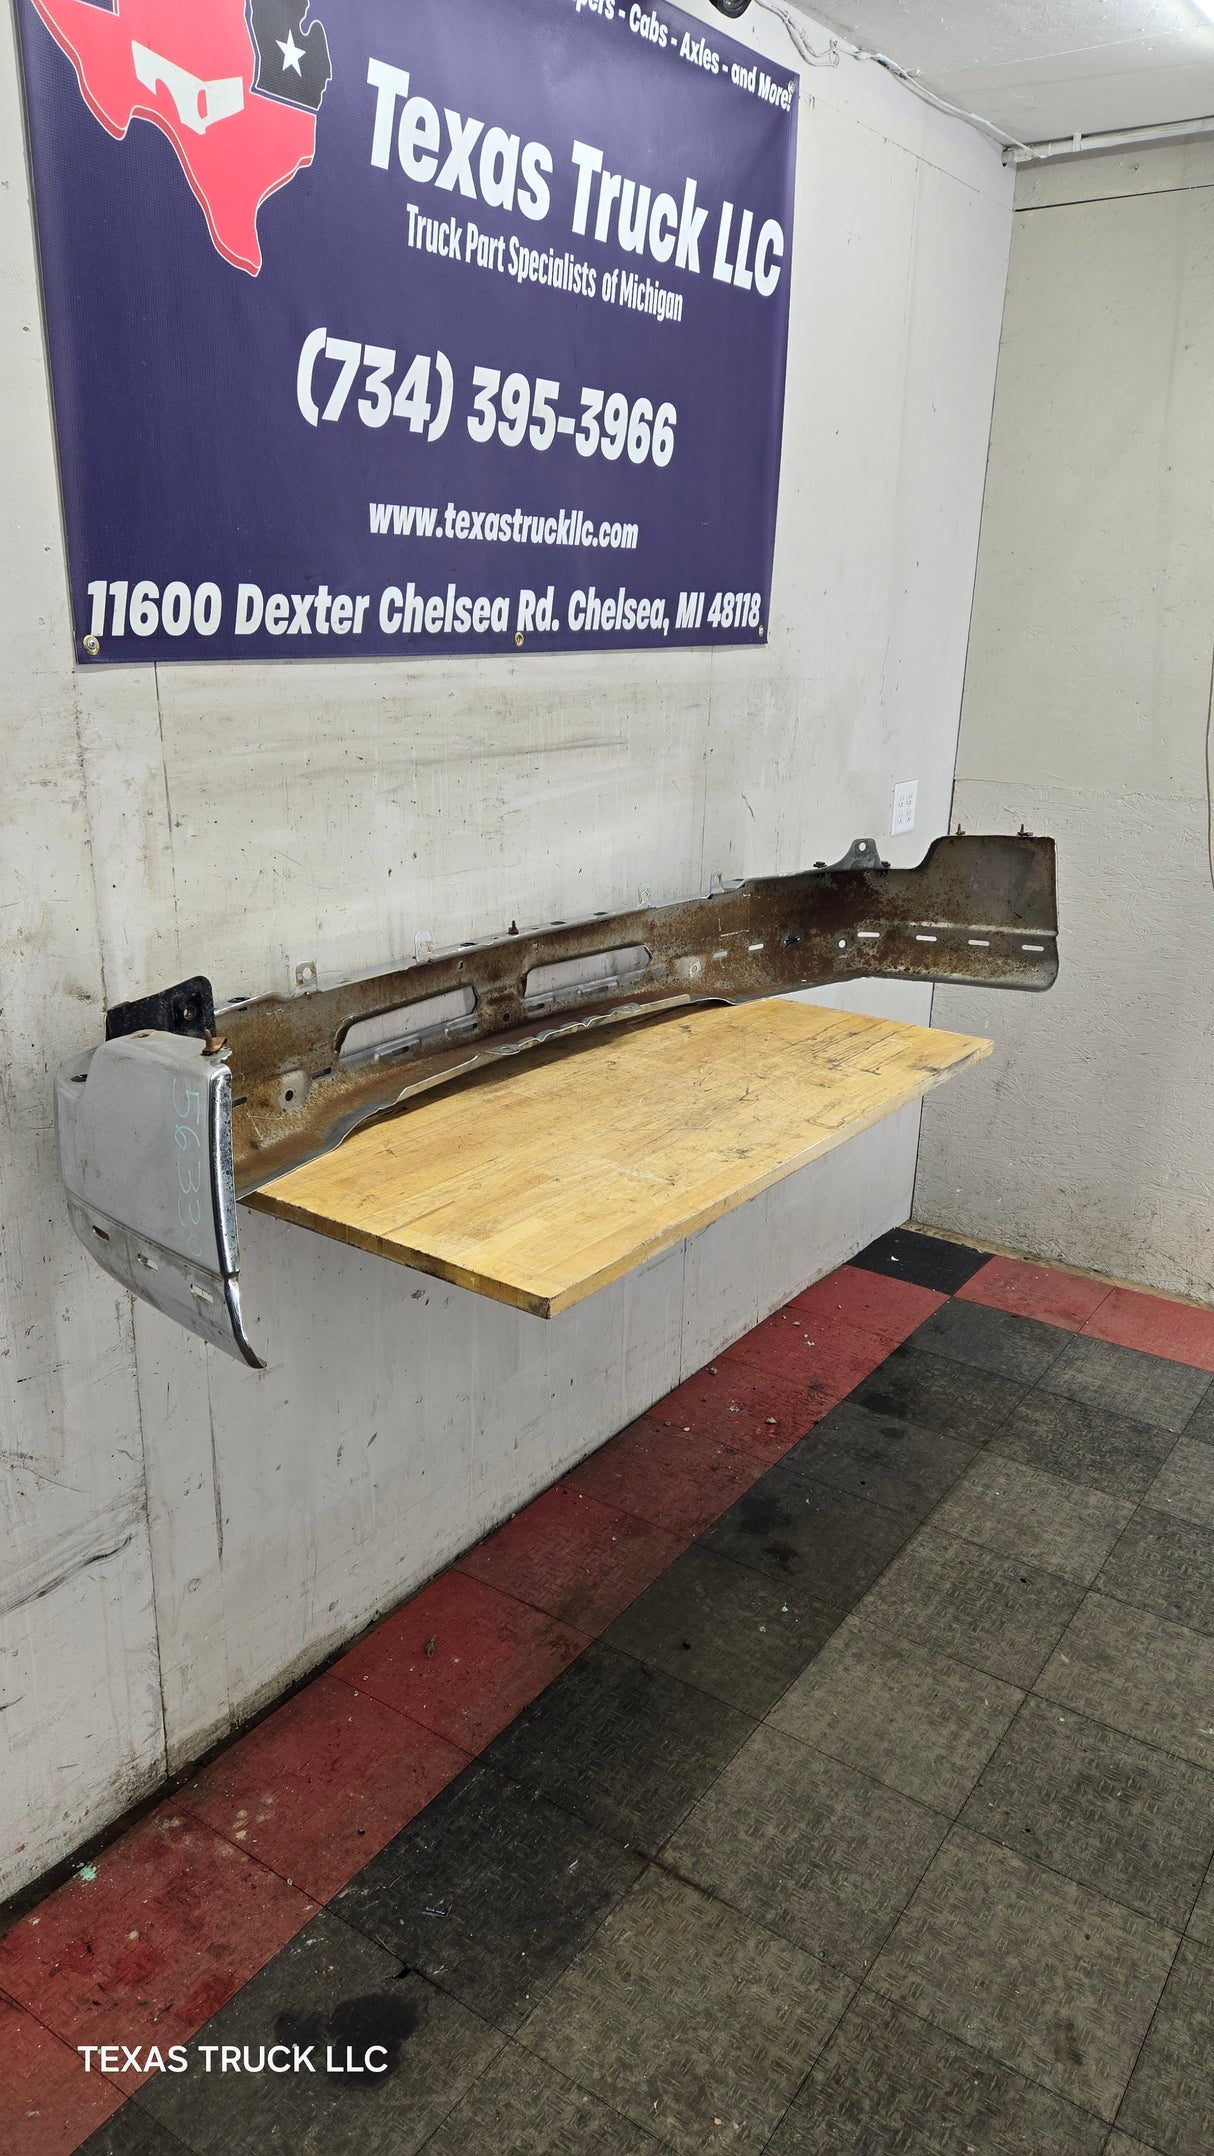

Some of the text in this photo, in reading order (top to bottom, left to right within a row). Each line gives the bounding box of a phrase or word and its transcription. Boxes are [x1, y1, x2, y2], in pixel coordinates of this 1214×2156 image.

[629, 3, 668, 48] Cabs
[679, 31, 719, 74] Axles
[731, 63, 756, 93] and
[757, 71, 793, 112] More!
[366, 56, 785, 297] Texas Truck LLC
[406, 202, 684, 322] Truck Part Specialists of Michigan
[296, 327, 677, 467] (734) 395-3966
[369, 502, 639, 549] www.texastruckllc.com
[86, 580, 761, 637] 11600 Dexter Chelsea Rd. Chelsea, MI 48118
